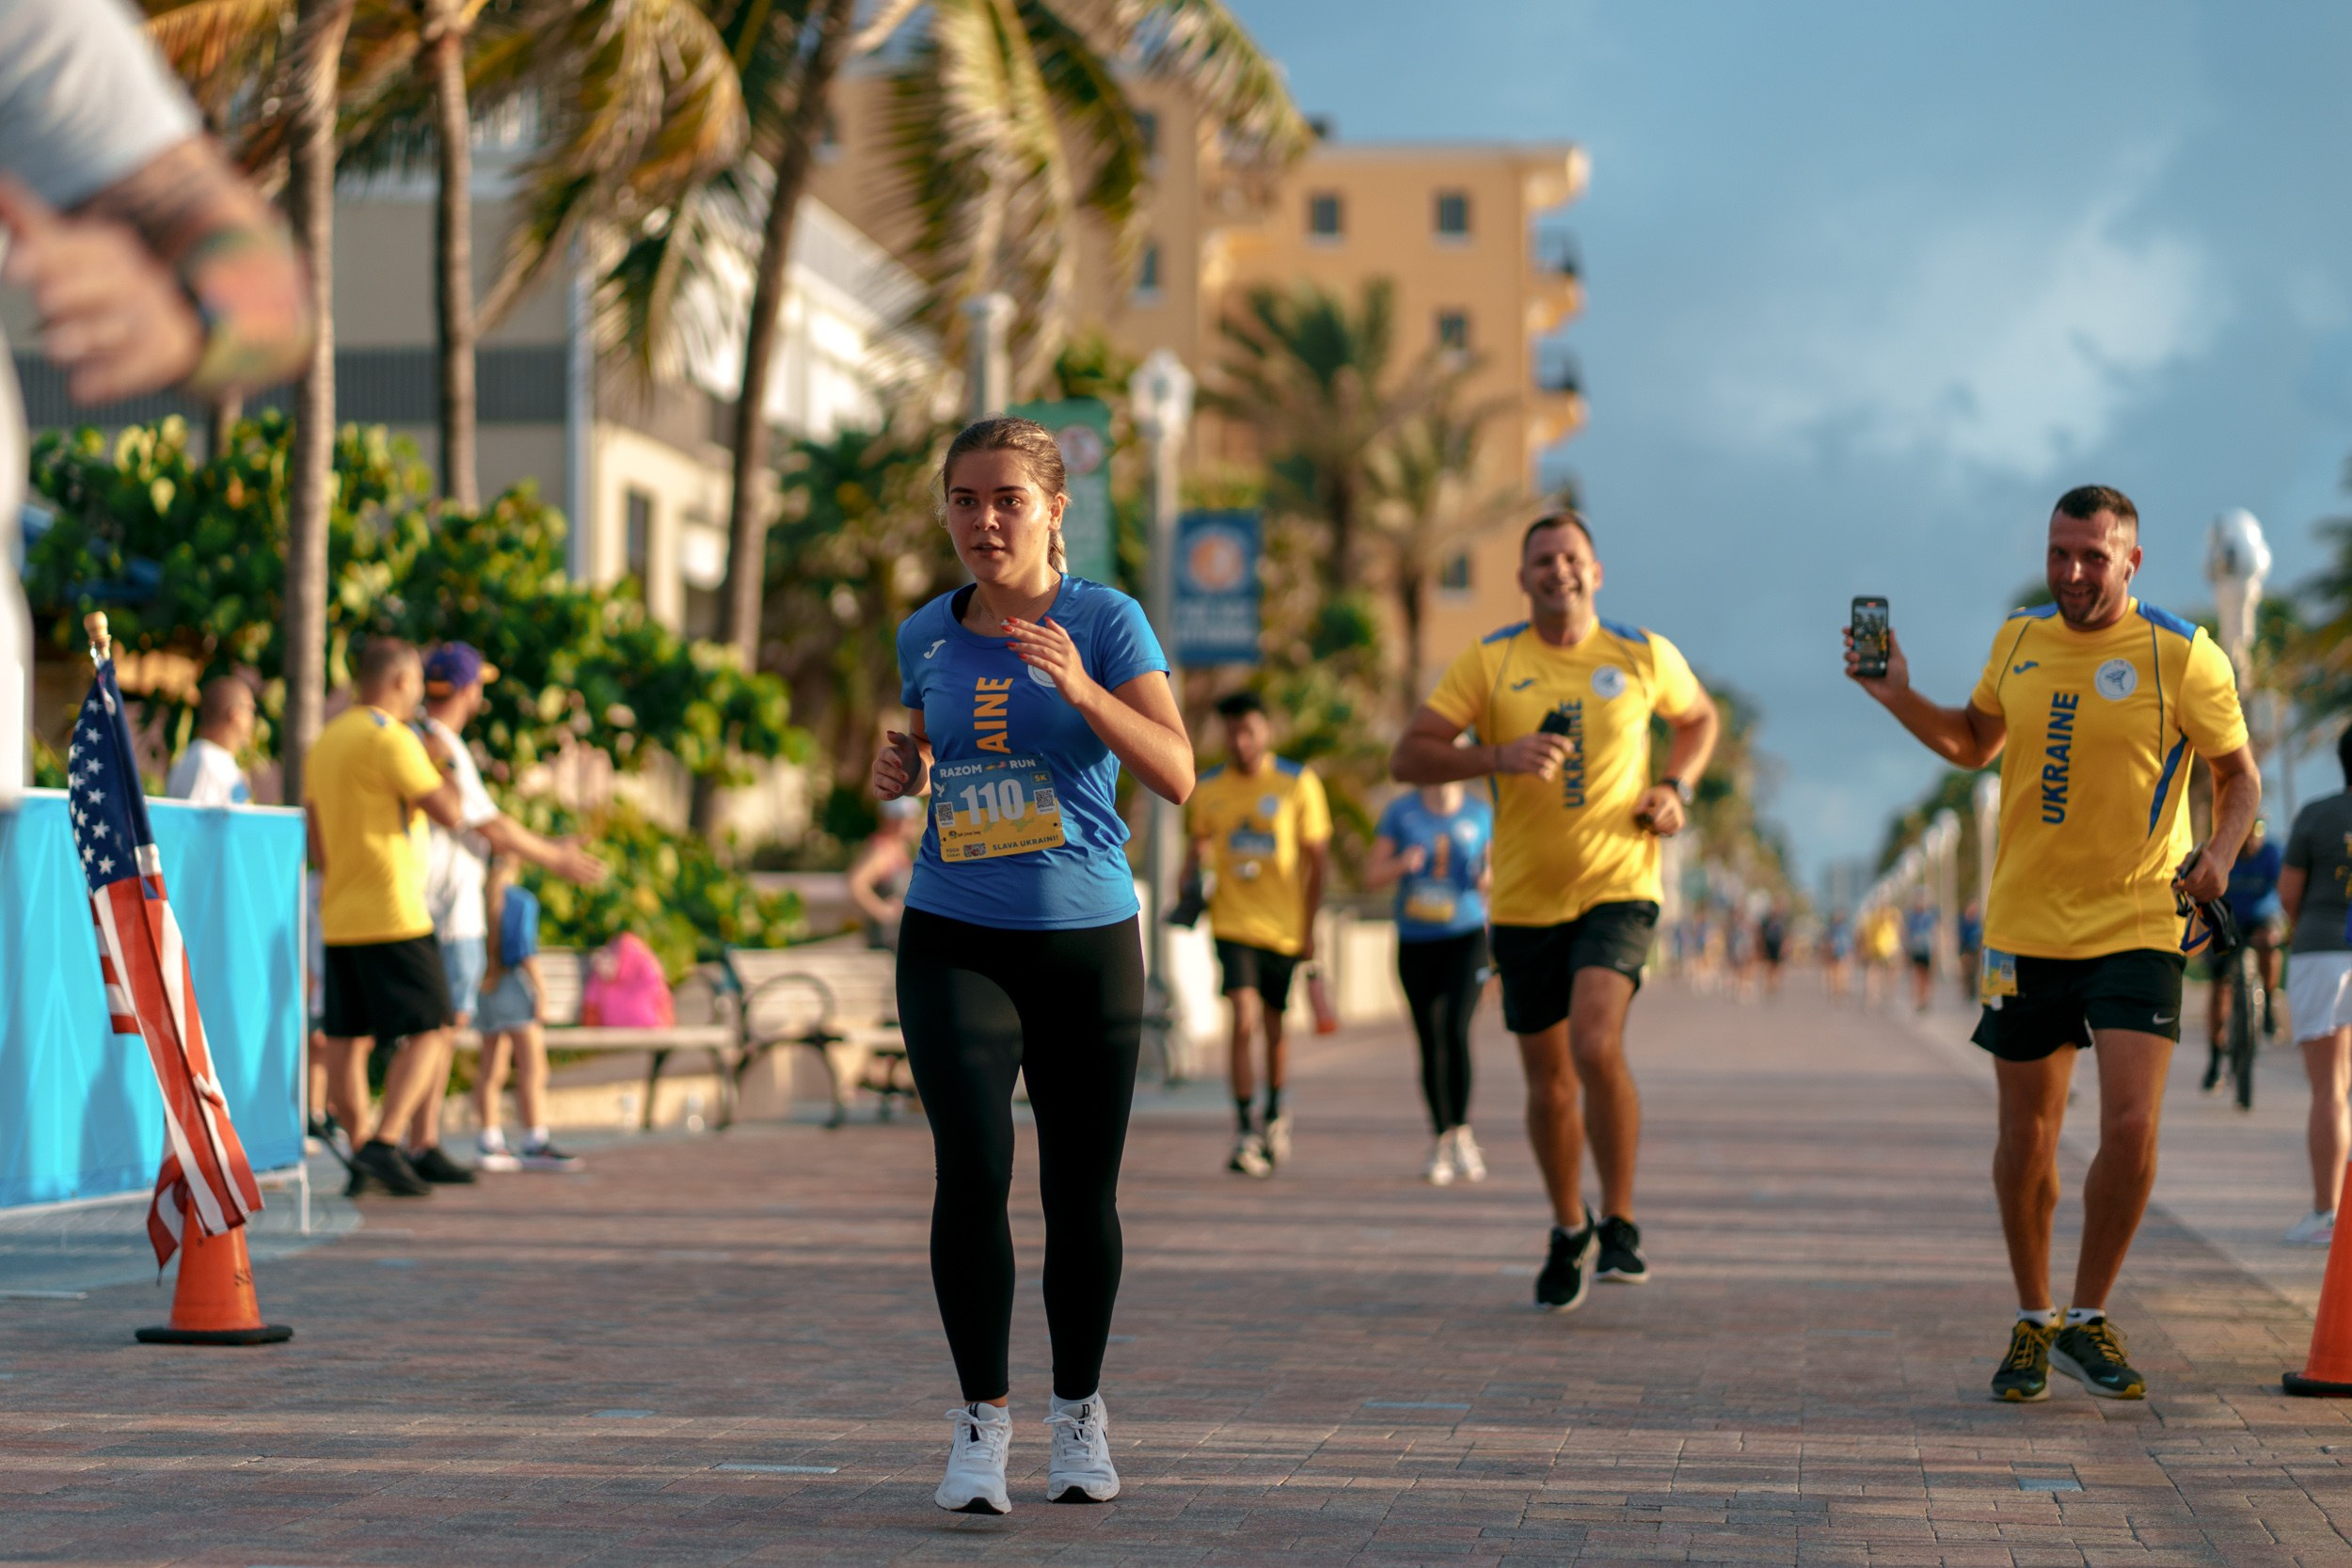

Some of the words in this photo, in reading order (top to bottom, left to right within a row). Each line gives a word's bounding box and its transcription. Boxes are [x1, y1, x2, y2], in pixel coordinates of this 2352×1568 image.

[973, 676, 1014, 753] AINE
[939, 764, 983, 778] RAZOM
[1009, 759, 1037, 769] RUN
[2041, 691, 2079, 825] UKRAINE
[959, 779, 1025, 825] 110
[993, 842, 1018, 851] SLAVA
[1020, 834, 1059, 847] UKRAINI!
